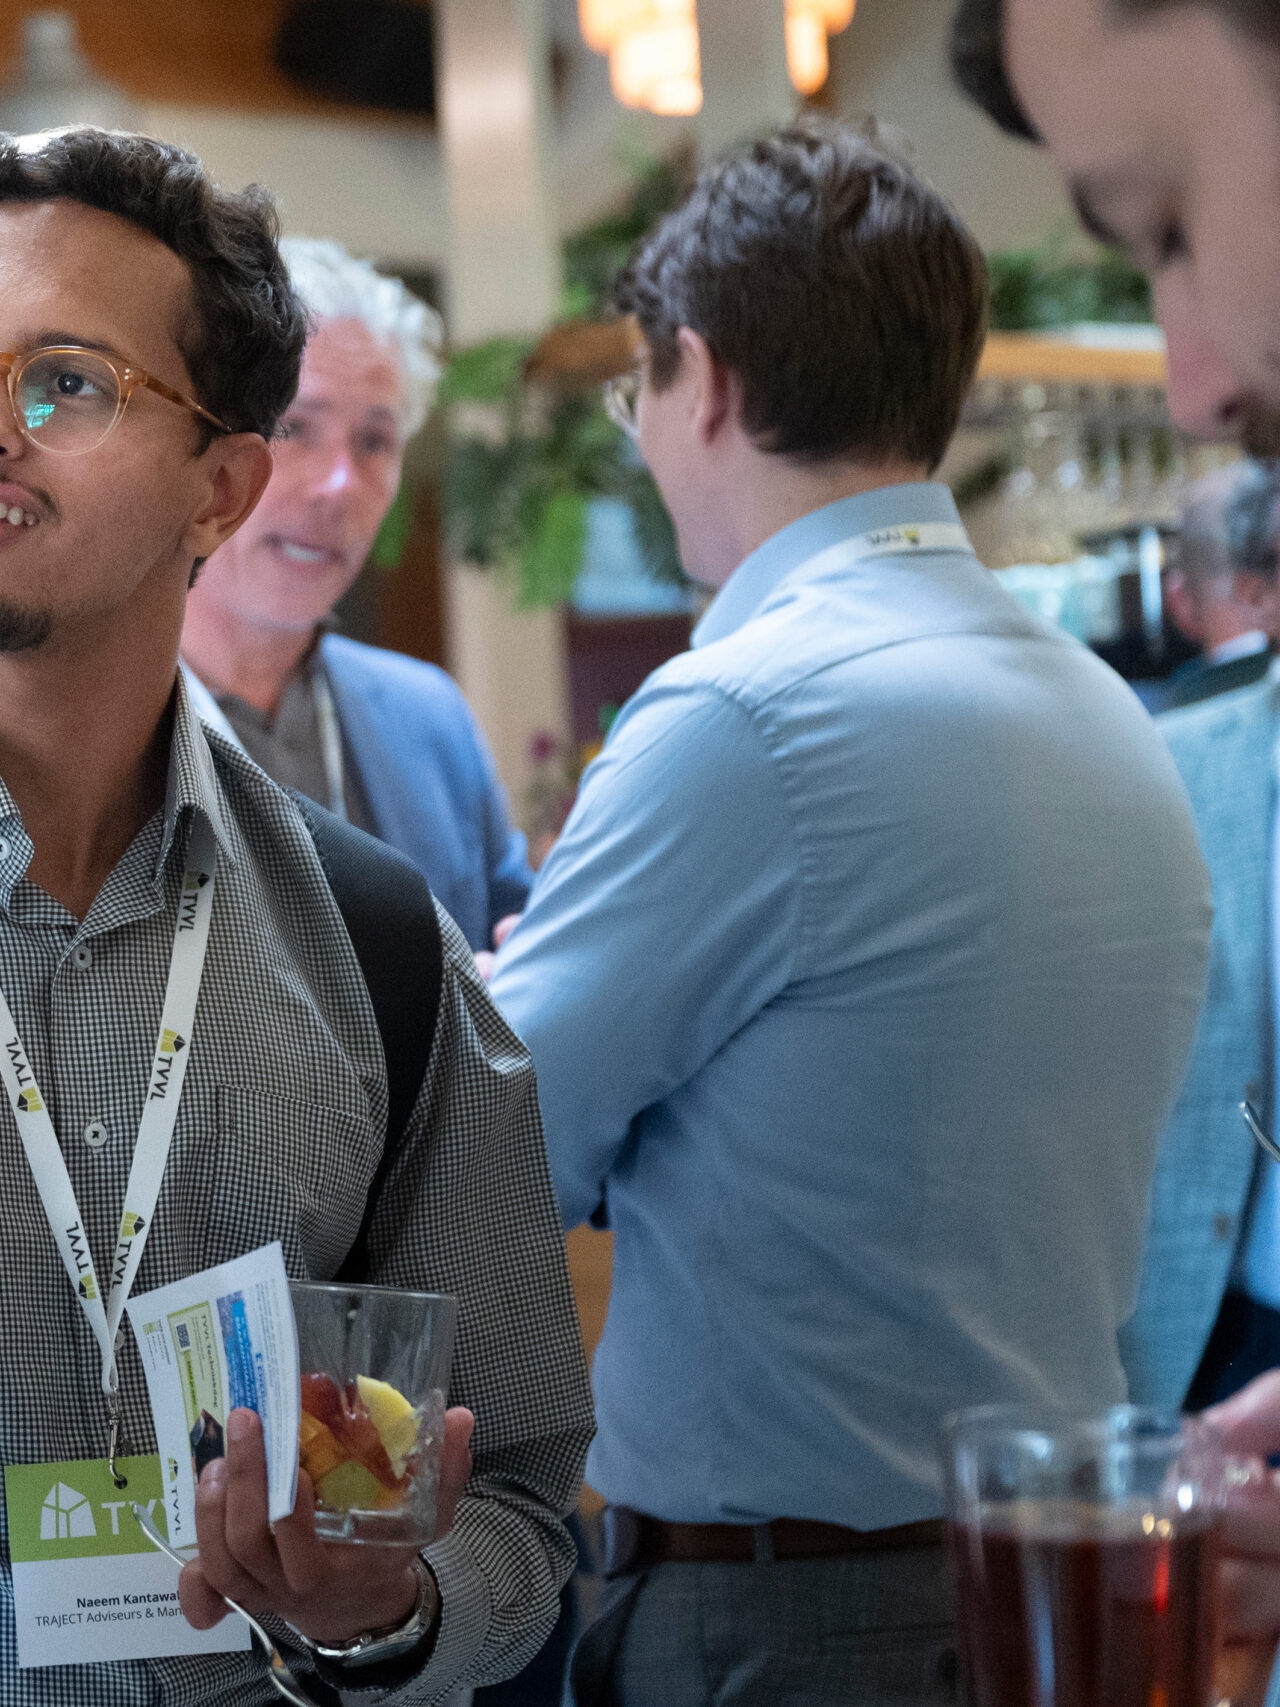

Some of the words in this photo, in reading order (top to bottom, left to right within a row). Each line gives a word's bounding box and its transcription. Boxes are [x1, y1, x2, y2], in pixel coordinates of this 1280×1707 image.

[179, 892, 201, 932] TVVL
[5, 1036, 32, 1087] TVVL
[151, 1056, 173, 1101] TVVL
[65, 1220, 89, 1273] TVVL
[112, 1240, 132, 1289] TVVL
[170, 1485, 182, 1536] TVVL
[35, 1613, 83, 1628] TRAJECT
[86, 1610, 142, 1623] Adviseurs
[145, 1608, 154, 1618] &
[157, 1607, 185, 1617] Man
[76, 1597, 120, 1608] Naeem
